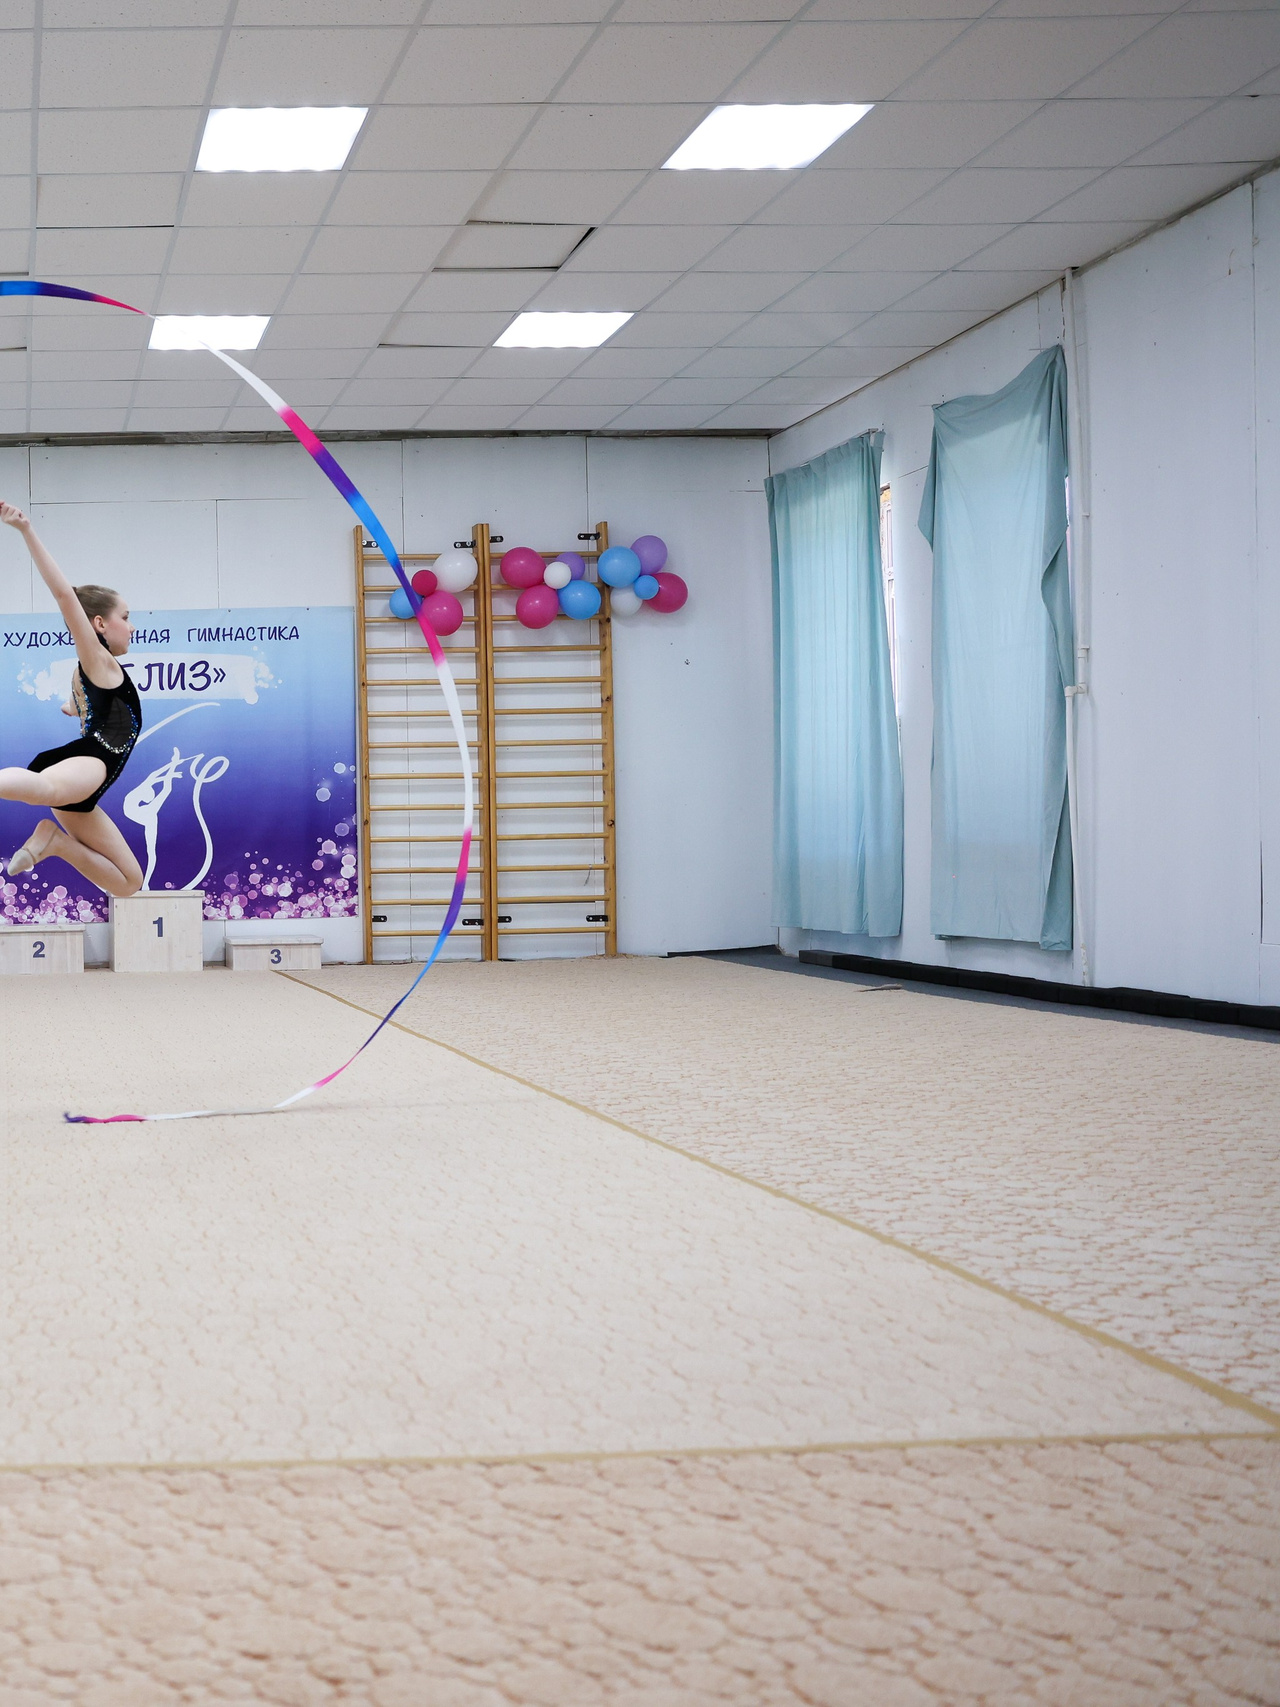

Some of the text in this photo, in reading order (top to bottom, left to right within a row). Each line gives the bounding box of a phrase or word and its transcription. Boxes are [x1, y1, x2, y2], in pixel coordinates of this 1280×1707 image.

[3, 626, 300, 649] ХУДОЖЕНАЯ ГИМНАСТИКА
[152, 916, 164, 938] 1
[32, 940, 46, 959] 2
[269, 948, 282, 965] 3
